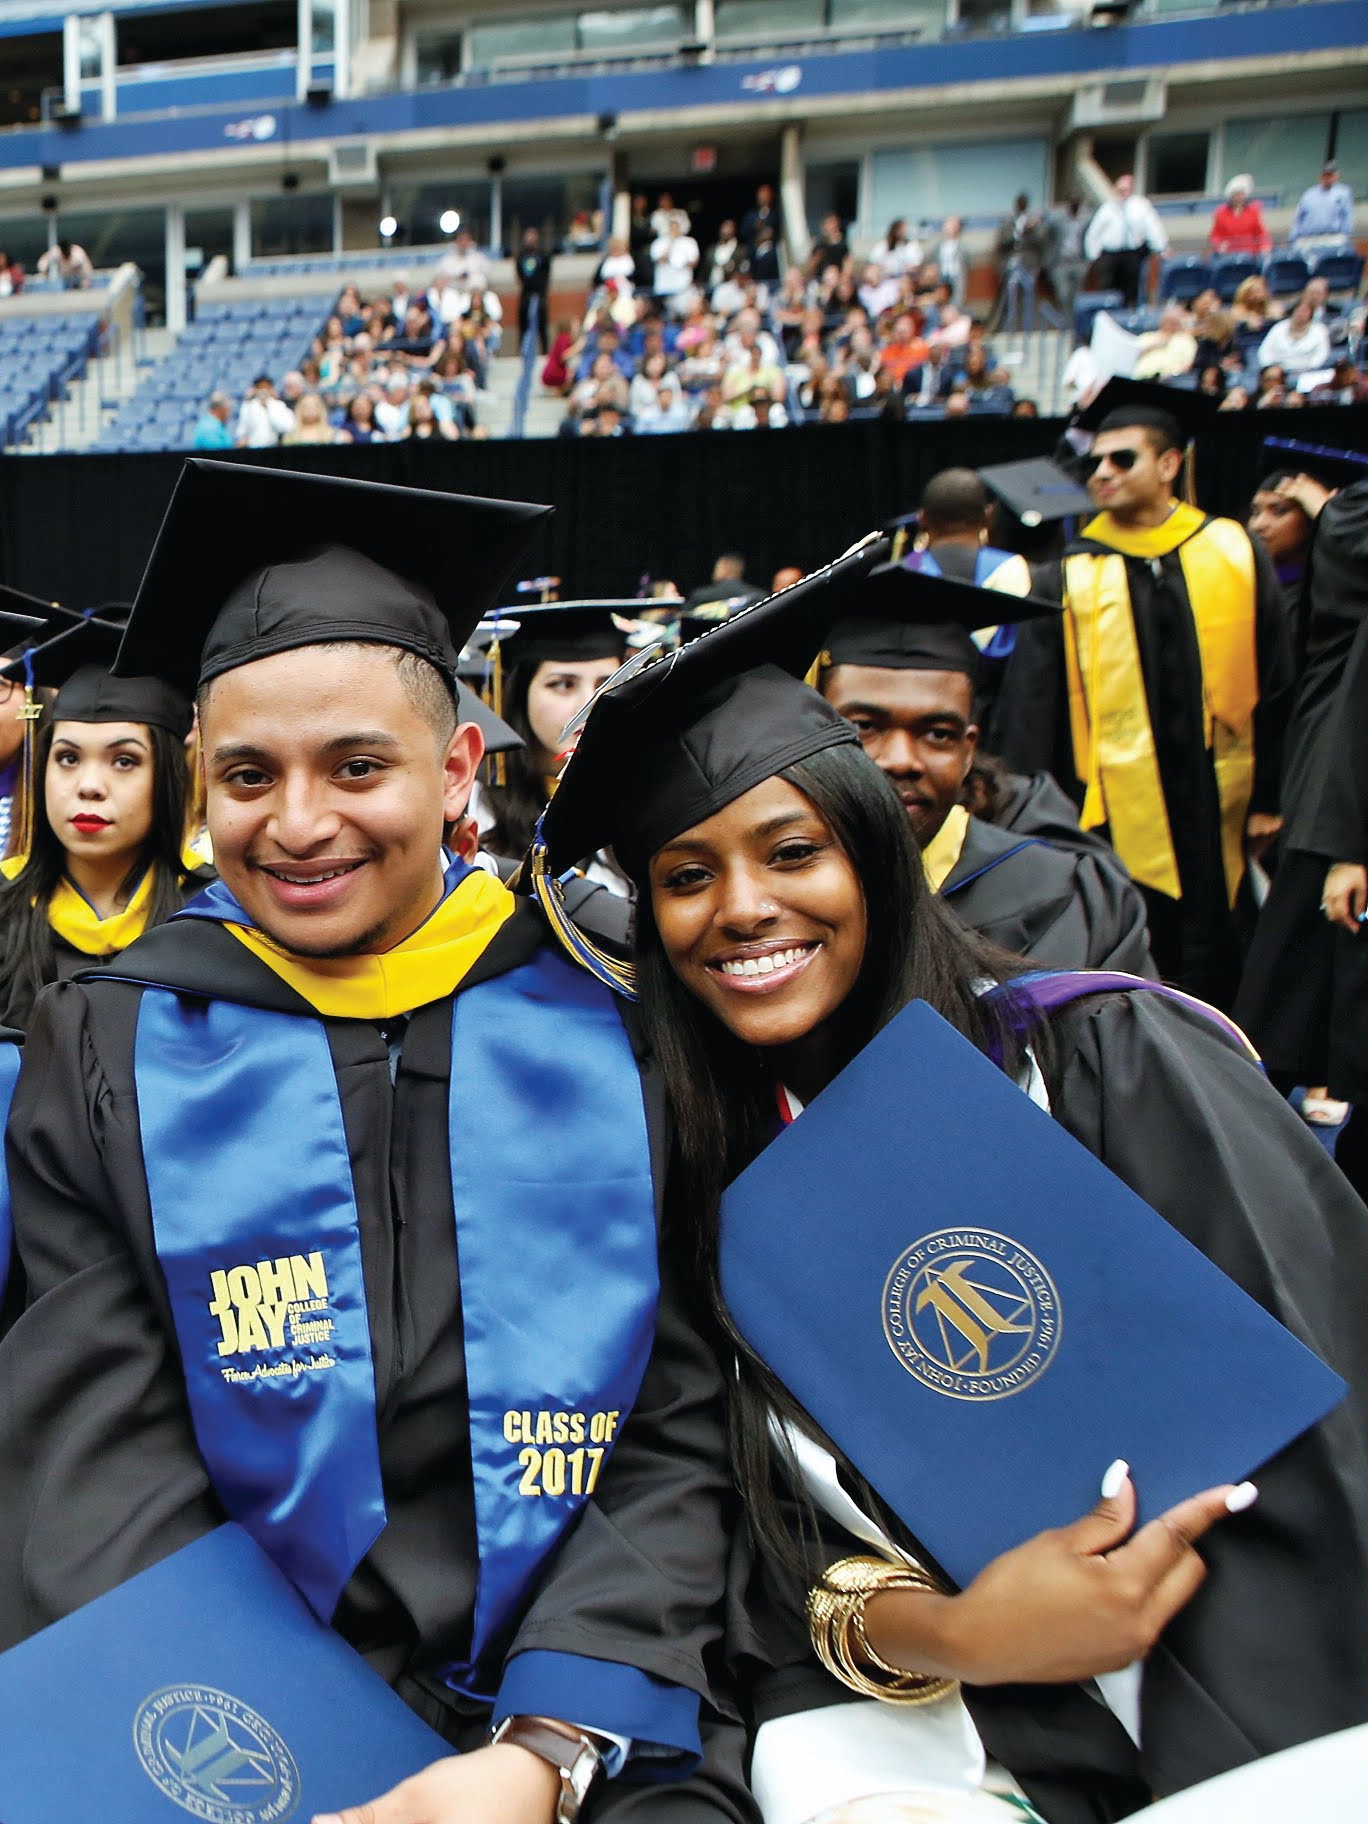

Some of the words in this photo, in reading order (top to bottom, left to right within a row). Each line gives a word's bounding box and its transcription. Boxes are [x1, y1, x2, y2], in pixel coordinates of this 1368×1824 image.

[907, 1249, 926, 1269] OF
[926, 1234, 1008, 1256] CRIMINAL
[209, 1251, 328, 1316] JOHN
[1006, 1251, 1055, 1313] JUSTICE
[889, 1267, 911, 1337] COLLEGE
[217, 1302, 289, 1357] JAY
[289, 1313, 301, 1325] OF
[290, 1318, 335, 1336] CRIMINAL
[292, 1331, 330, 1346] JUSTICE
[897, 1341, 924, 1364] JAY
[968, 1352, 1042, 1394] FOUNDED
[1036, 1318, 1056, 1350] 1964
[917, 1361, 963, 1392] JOHN
[503, 1410, 586, 1445] CLASS
[589, 1410, 620, 1444] OF
[518, 1447, 605, 1496] 2017
